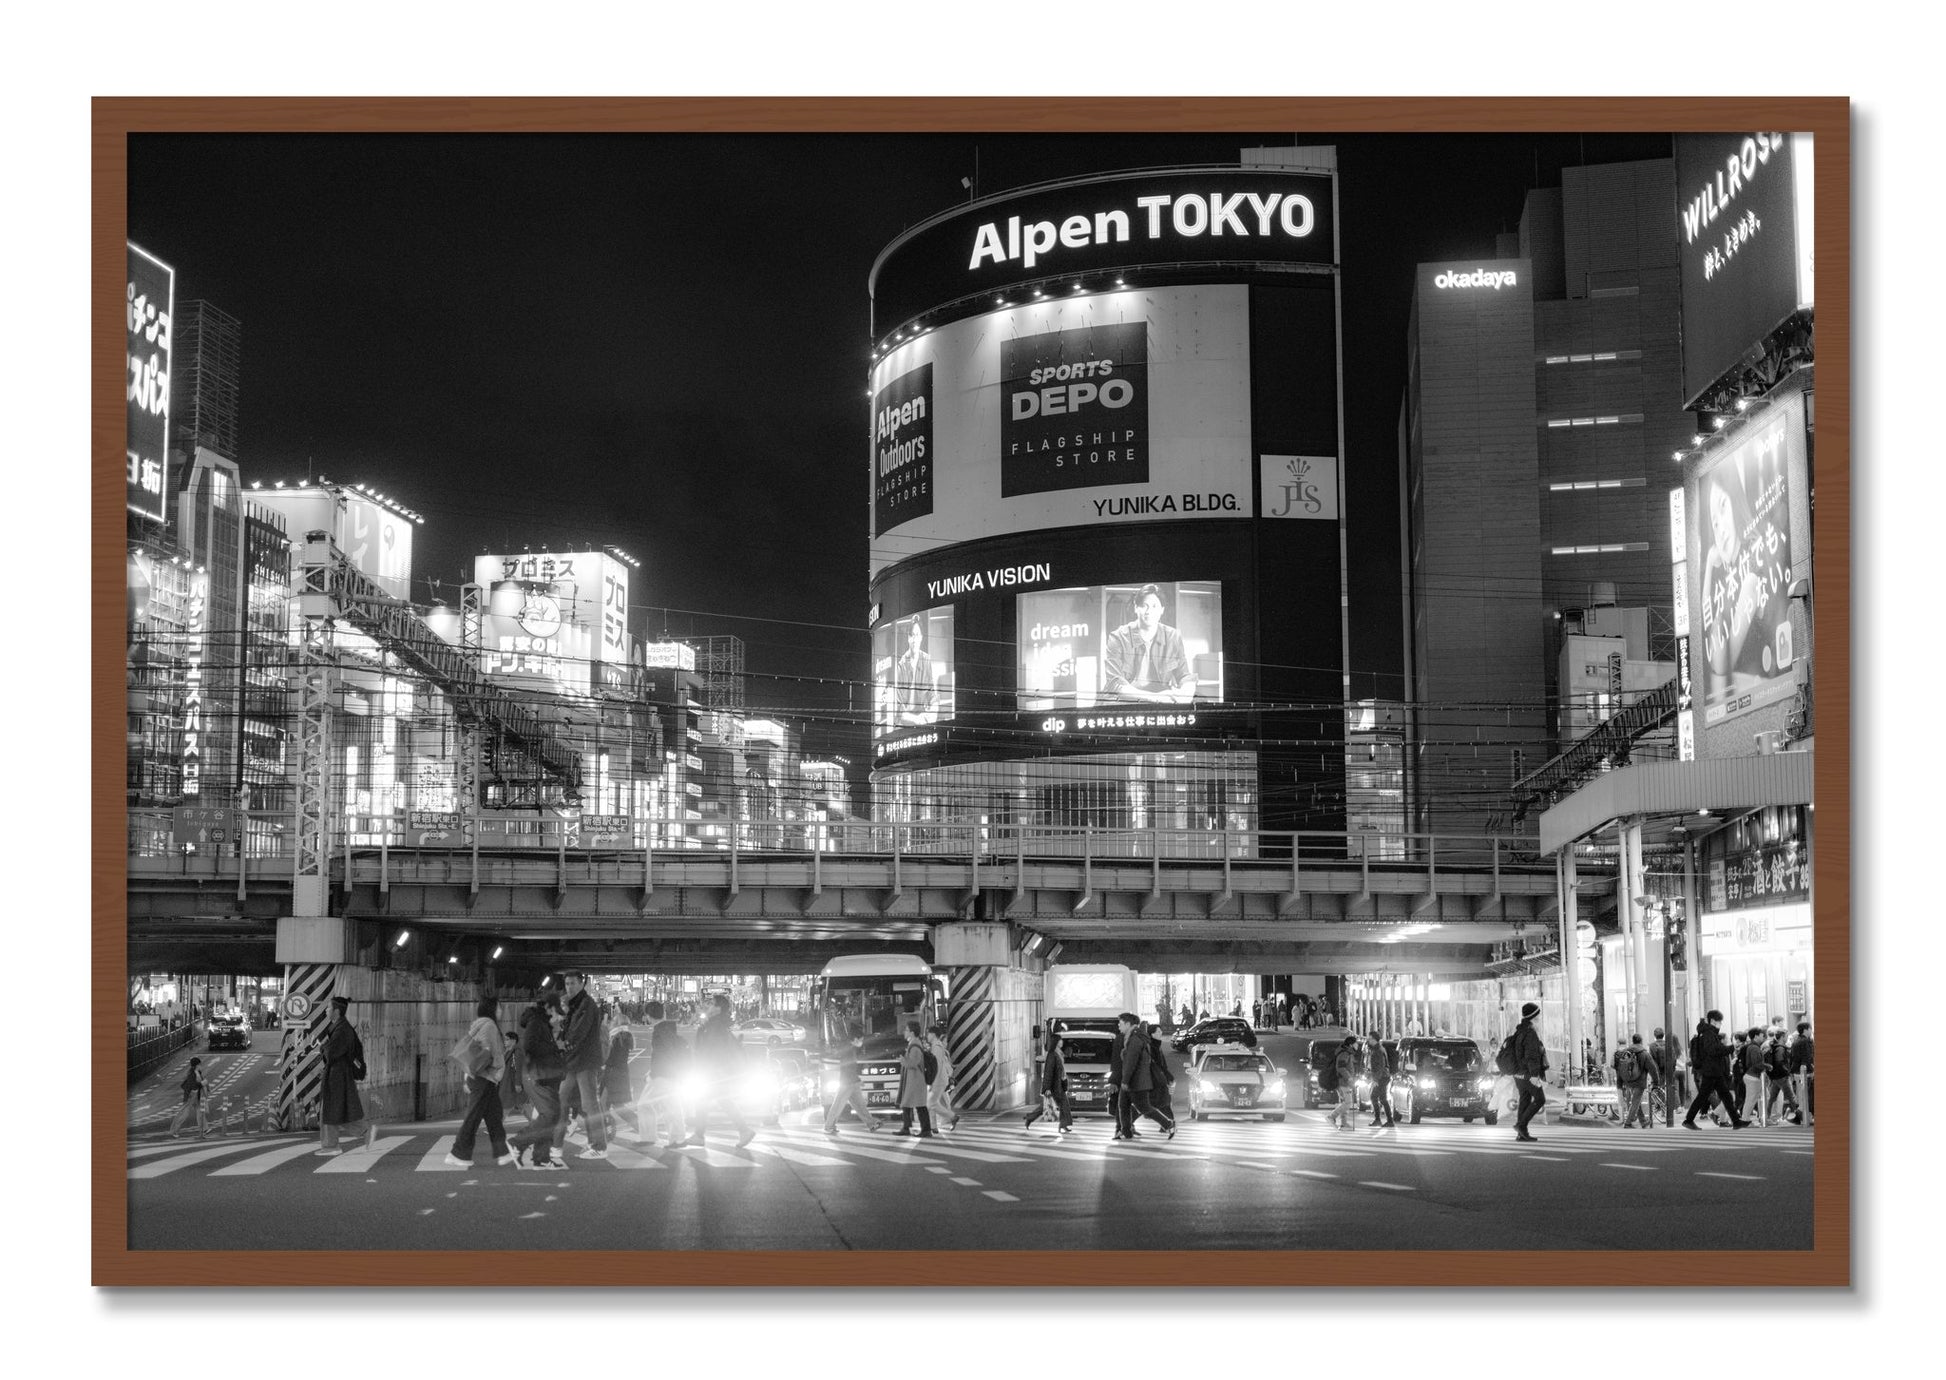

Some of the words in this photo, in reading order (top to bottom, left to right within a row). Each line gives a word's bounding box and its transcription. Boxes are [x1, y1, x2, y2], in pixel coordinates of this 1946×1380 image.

[968, 207, 1131, 271] Alpen
[1137, 192, 1315, 240] TOKYO
[1434, 268, 1517, 290] okadaya
[1029, 359, 1113, 385] SPORTS
[127, 353, 168, 420] スパス
[1011, 378, 1134, 422] DEPO
[877, 395, 926, 444] Alpen
[1011, 430, 1134, 455] FLAGSHIP
[880, 434, 925, 478] Outdoors
[1056, 449, 1135, 467] STORE
[877, 465, 926, 499] FLAGSHIP
[890, 482, 926, 507] STORE
[1093, 495, 1177, 517] YUNIKA
[1182, 493, 1241, 512] BLDG.
[254, 563, 285, 584] SHISHA
[502, 558, 576, 579] プロミス
[928, 573, 984, 599] YUNIKA
[987, 563, 1050, 588] VISION
[1702, 522, 1787, 632] 自分本位でも、
[1705, 562, 1791, 662] いいじゃない。
[1030, 622, 1089, 642] dream
[1042, 717, 1066, 733] dip
